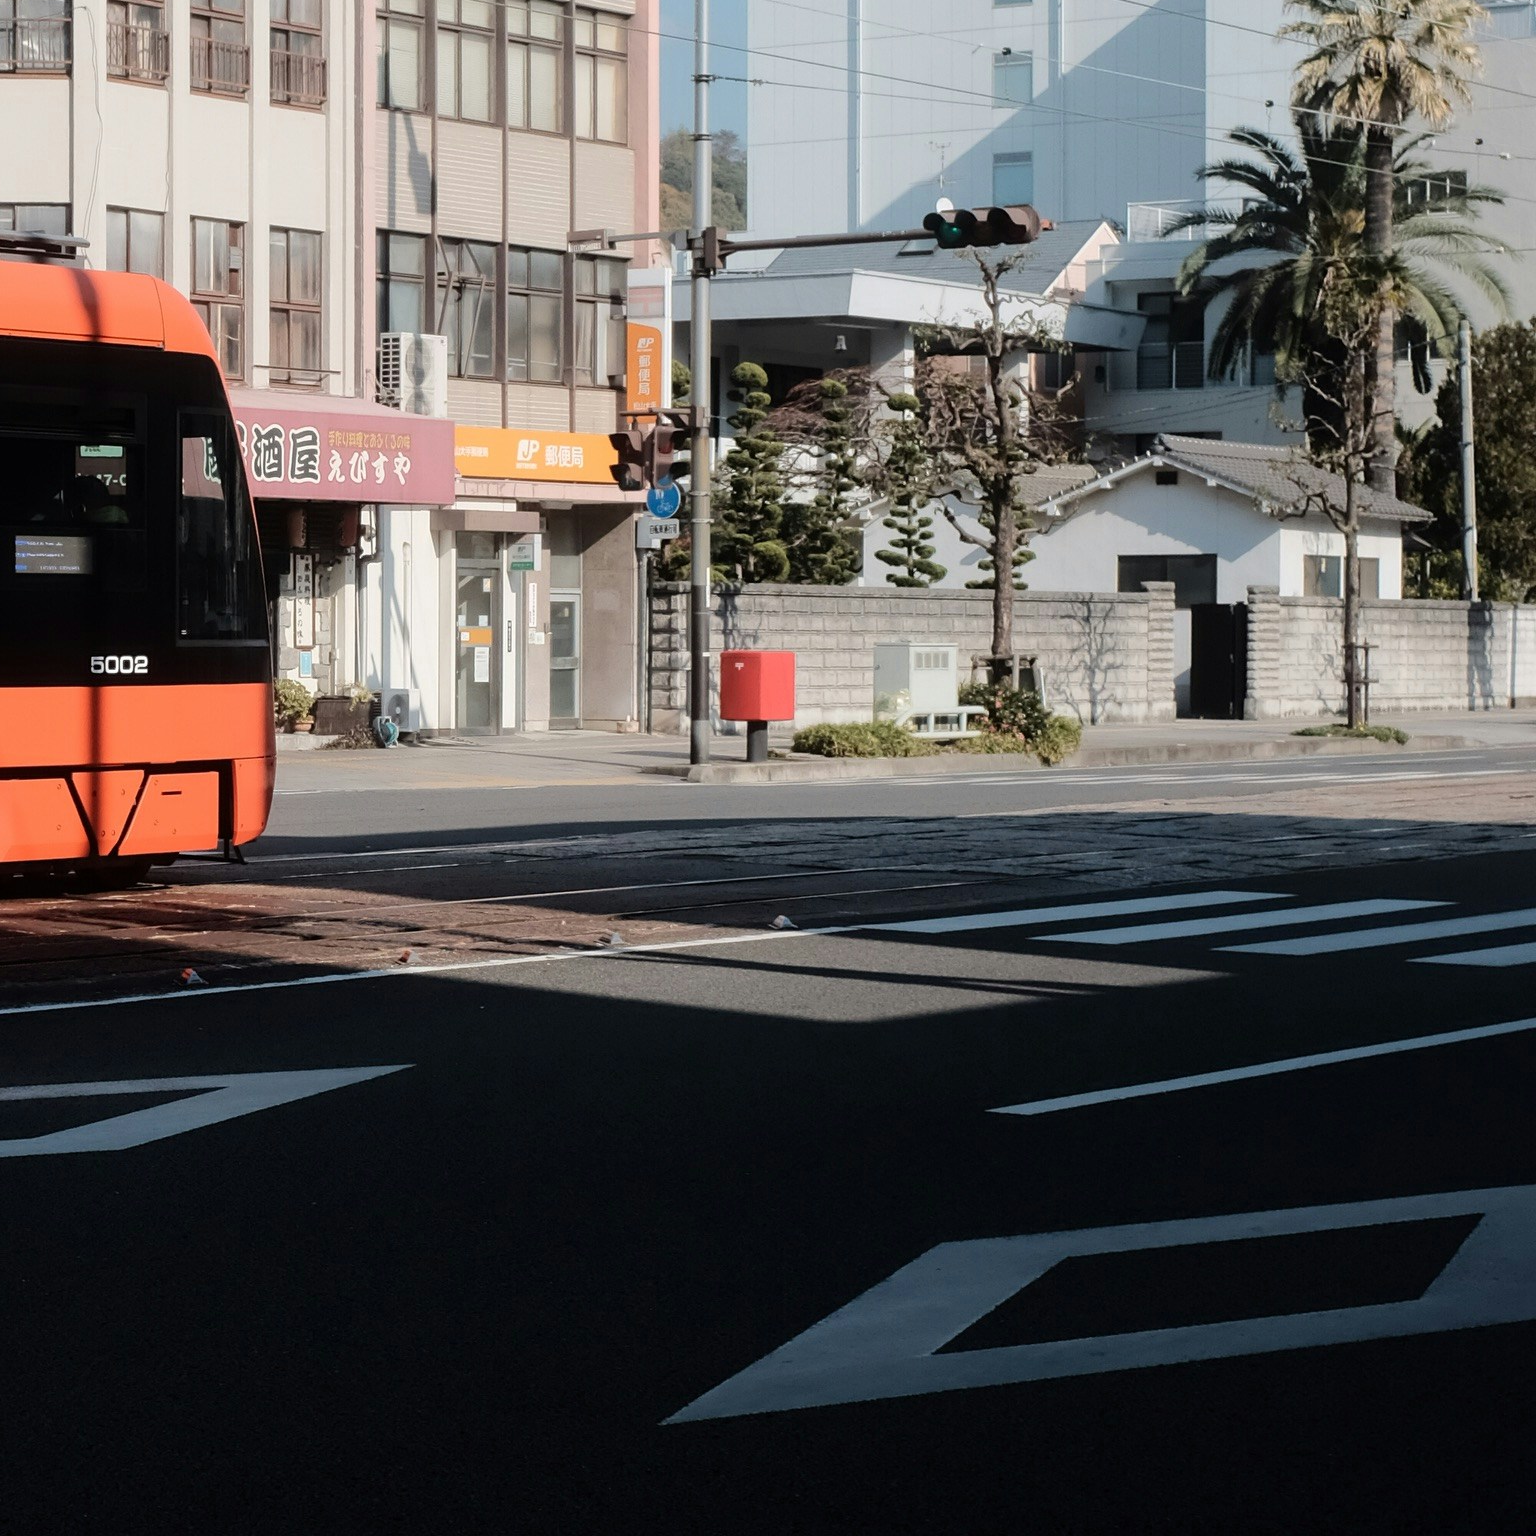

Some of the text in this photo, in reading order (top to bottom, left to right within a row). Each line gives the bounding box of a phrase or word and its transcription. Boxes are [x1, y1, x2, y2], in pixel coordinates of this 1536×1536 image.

[638, 354, 651, 396] 郵便局
[328, 449, 412, 485] えびすや
[545, 444, 584, 469] 郵便局
[90, 655, 149, 674] 5002
